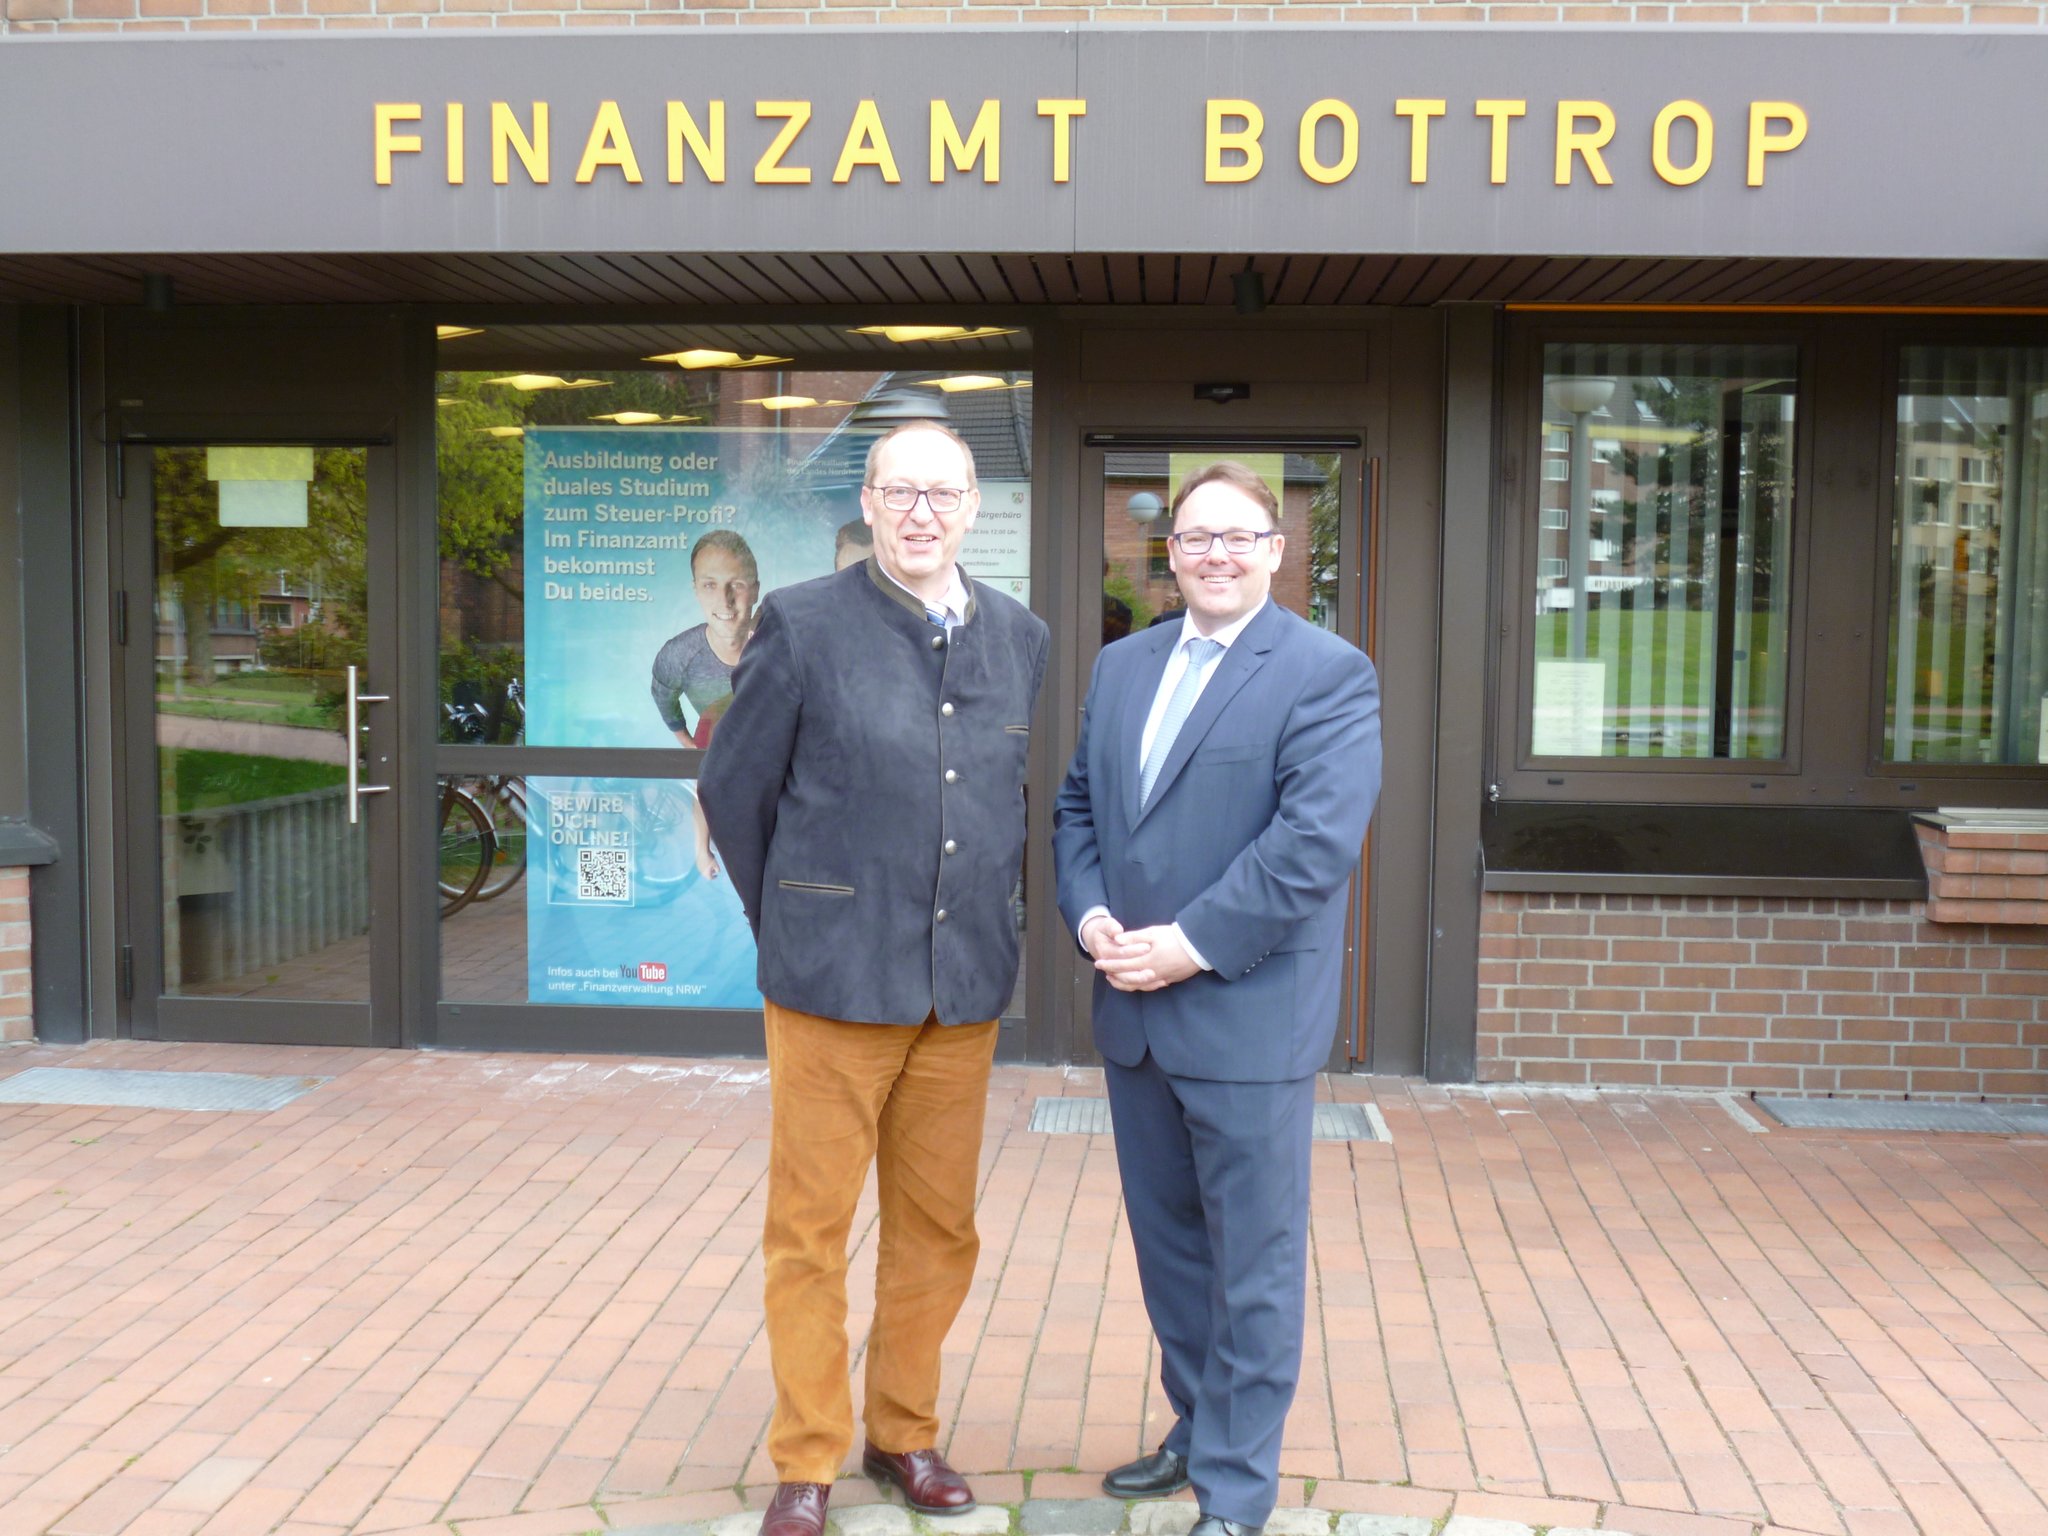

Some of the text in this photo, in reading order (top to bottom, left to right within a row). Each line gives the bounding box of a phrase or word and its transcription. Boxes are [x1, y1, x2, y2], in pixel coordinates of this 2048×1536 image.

[374, 97, 1808, 187] FINANZAMT BOTTROP
[544, 451, 718, 474] Ausbildung oder
[544, 478, 709, 497] duales Studium
[544, 504, 736, 524] zum Steuer-Profi?
[544, 530, 688, 549] Im Finanzamt
[544, 556, 656, 576] bekommst
[544, 582, 653, 601] Du beides.
[551, 796, 624, 813] BEWIRB
[551, 812, 597, 829] DICH
[551, 830, 629, 847] ONLINE!
[548, 966, 572, 977] Infos
[575, 967, 600, 978] auch
[602, 968, 618, 978] bei
[548, 981, 576, 991] unter
